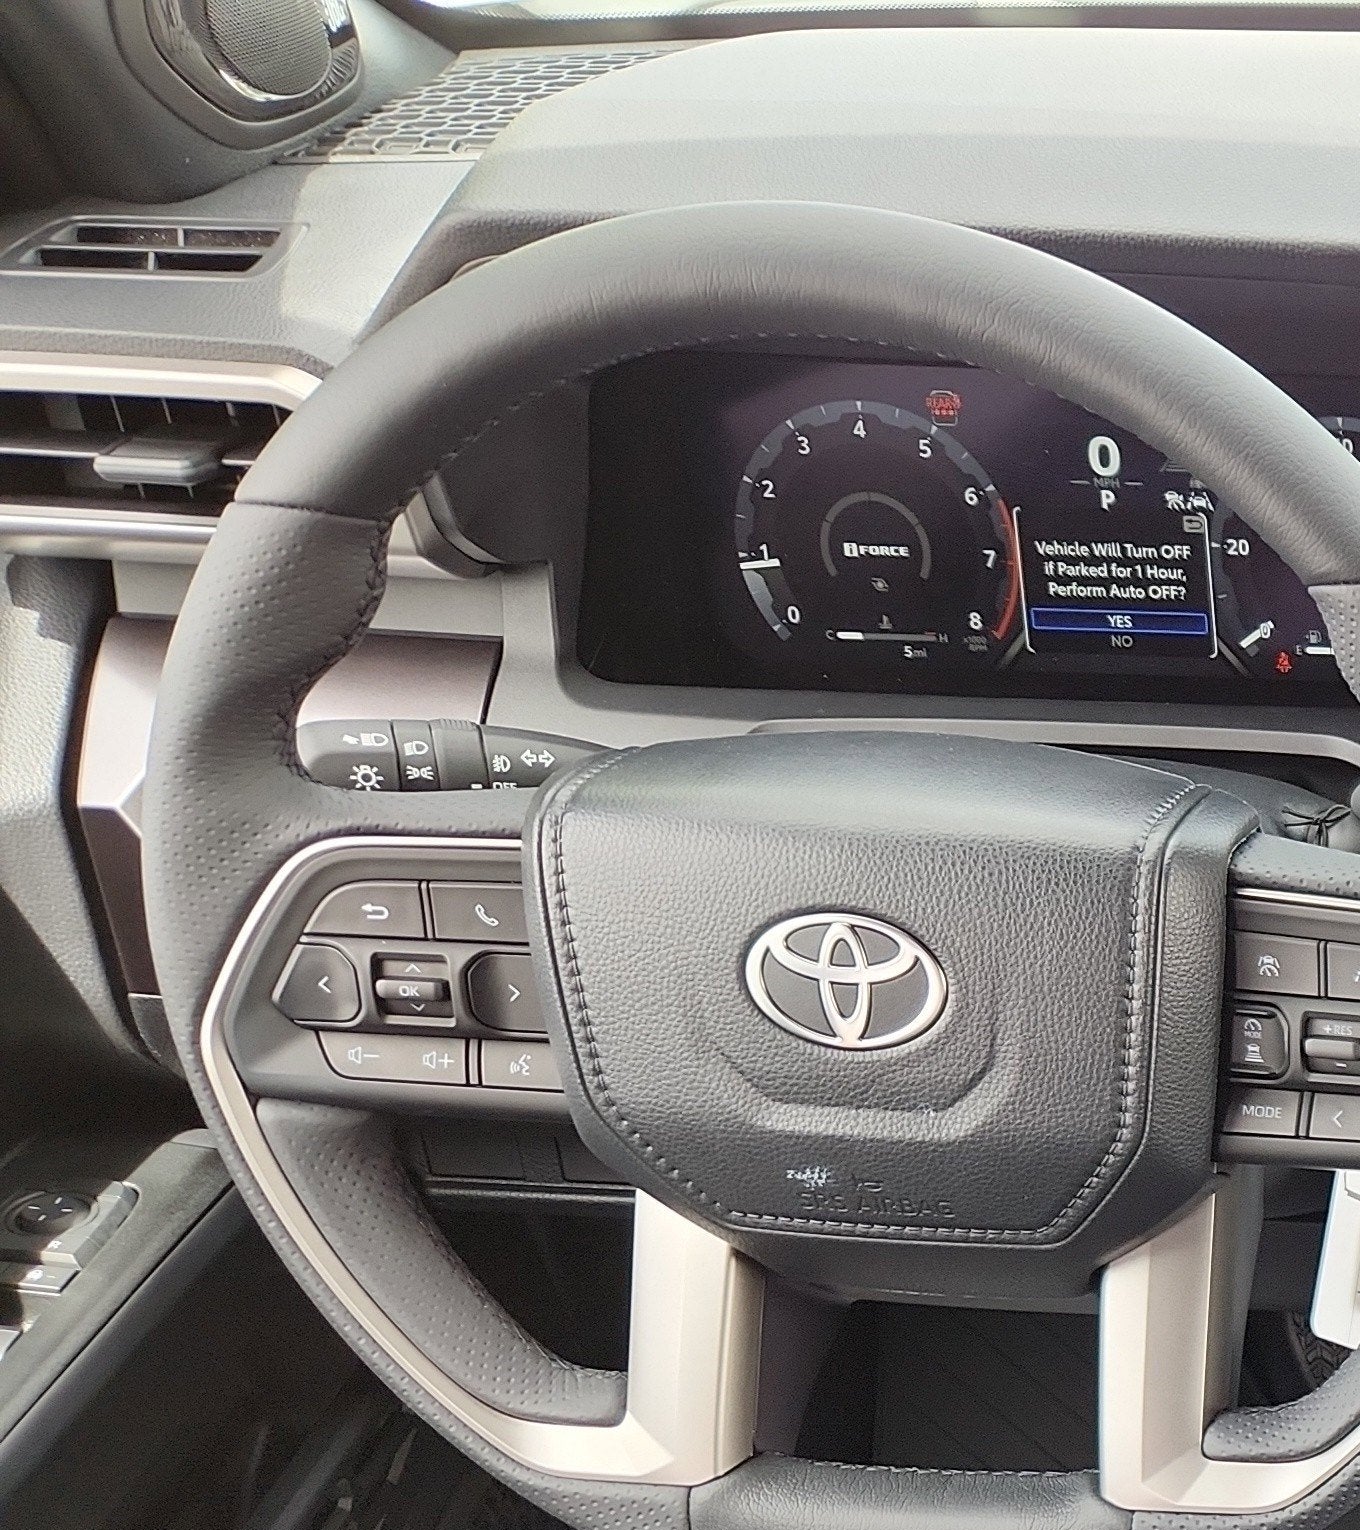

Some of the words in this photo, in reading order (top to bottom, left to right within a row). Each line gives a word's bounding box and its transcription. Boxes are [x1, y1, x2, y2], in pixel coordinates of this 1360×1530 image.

[853, 419, 866, 438] 4
[798, 436, 810, 454] 3
[918, 440, 932, 458] 5
[1088, 436, 1121, 477] 0
[762, 480, 776, 498] 2
[964, 488, 979, 505] 6
[1101, 490, 1116, 510] P
[760, 544, 769, 561] 1
[1034, 541, 1090, 557] Vehicle
[1093, 542, 1122, 558] Will
[1123, 545, 1158, 559] Turn
[1161, 546, 1191, 560] OFF
[1227, 539, 1249, 555] 20
[983, 550, 997, 568] 7
[1044, 561, 1056, 576] if
[1057, 562, 1108, 578] Parked
[1110, 563, 1132, 578] for
[1135, 565, 1142, 578] 1
[1146, 565, 1187, 582] Hour,
[1048, 582, 1106, 597] Perform
[1110, 584, 1145, 598] Auto
[1149, 586, 1186, 600] OFF?
[787, 606, 800, 624] 0
[968, 611, 983, 630] 8
[1107, 615, 1133, 628] YES
[1111, 635, 1133, 648] NO
[399, 985, 420, 998] OK
[1242, 1105, 1282, 1119] MODE
